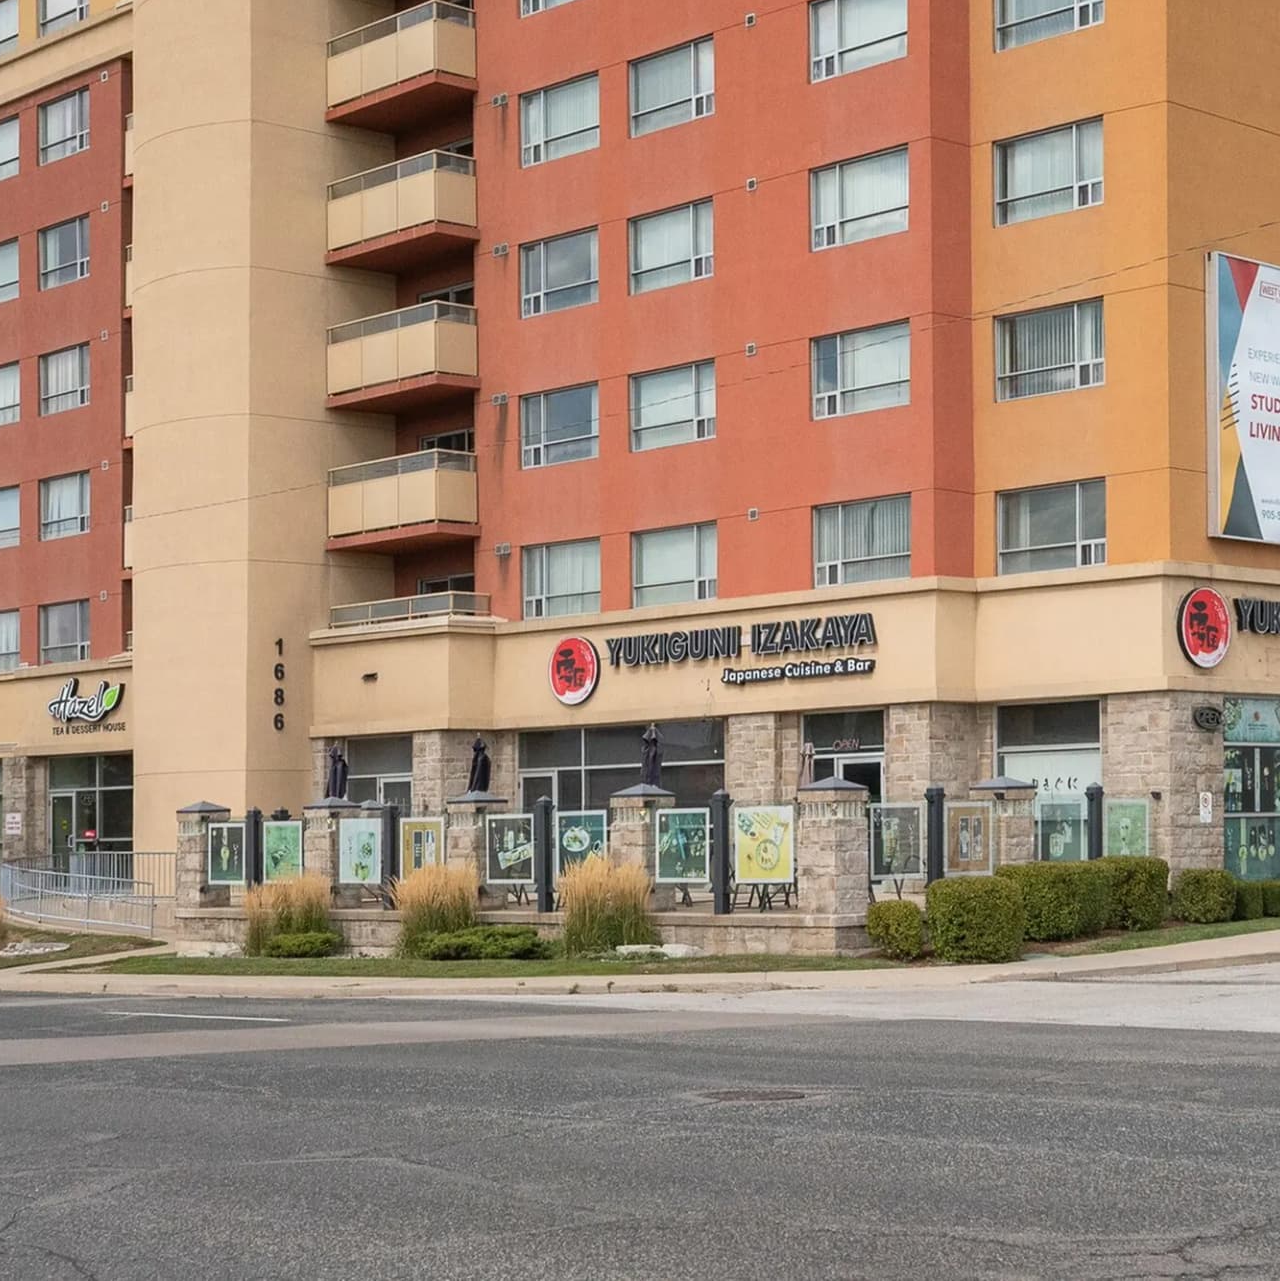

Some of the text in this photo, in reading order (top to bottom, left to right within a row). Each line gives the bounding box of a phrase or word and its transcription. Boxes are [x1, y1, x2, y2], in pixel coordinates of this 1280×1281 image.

[1249, 370, 1269, 384] NEW
[606, 612, 877, 667] YUKIGUNI IZAKAYA
[722, 659, 872, 684] Japanese Cuisine & Bar
[48, 677, 114, 723] Hazel
[52, 726, 65, 735] TEA
[71, 723, 101, 734] DESSERT
[102, 721, 126, 732] HOUSE
